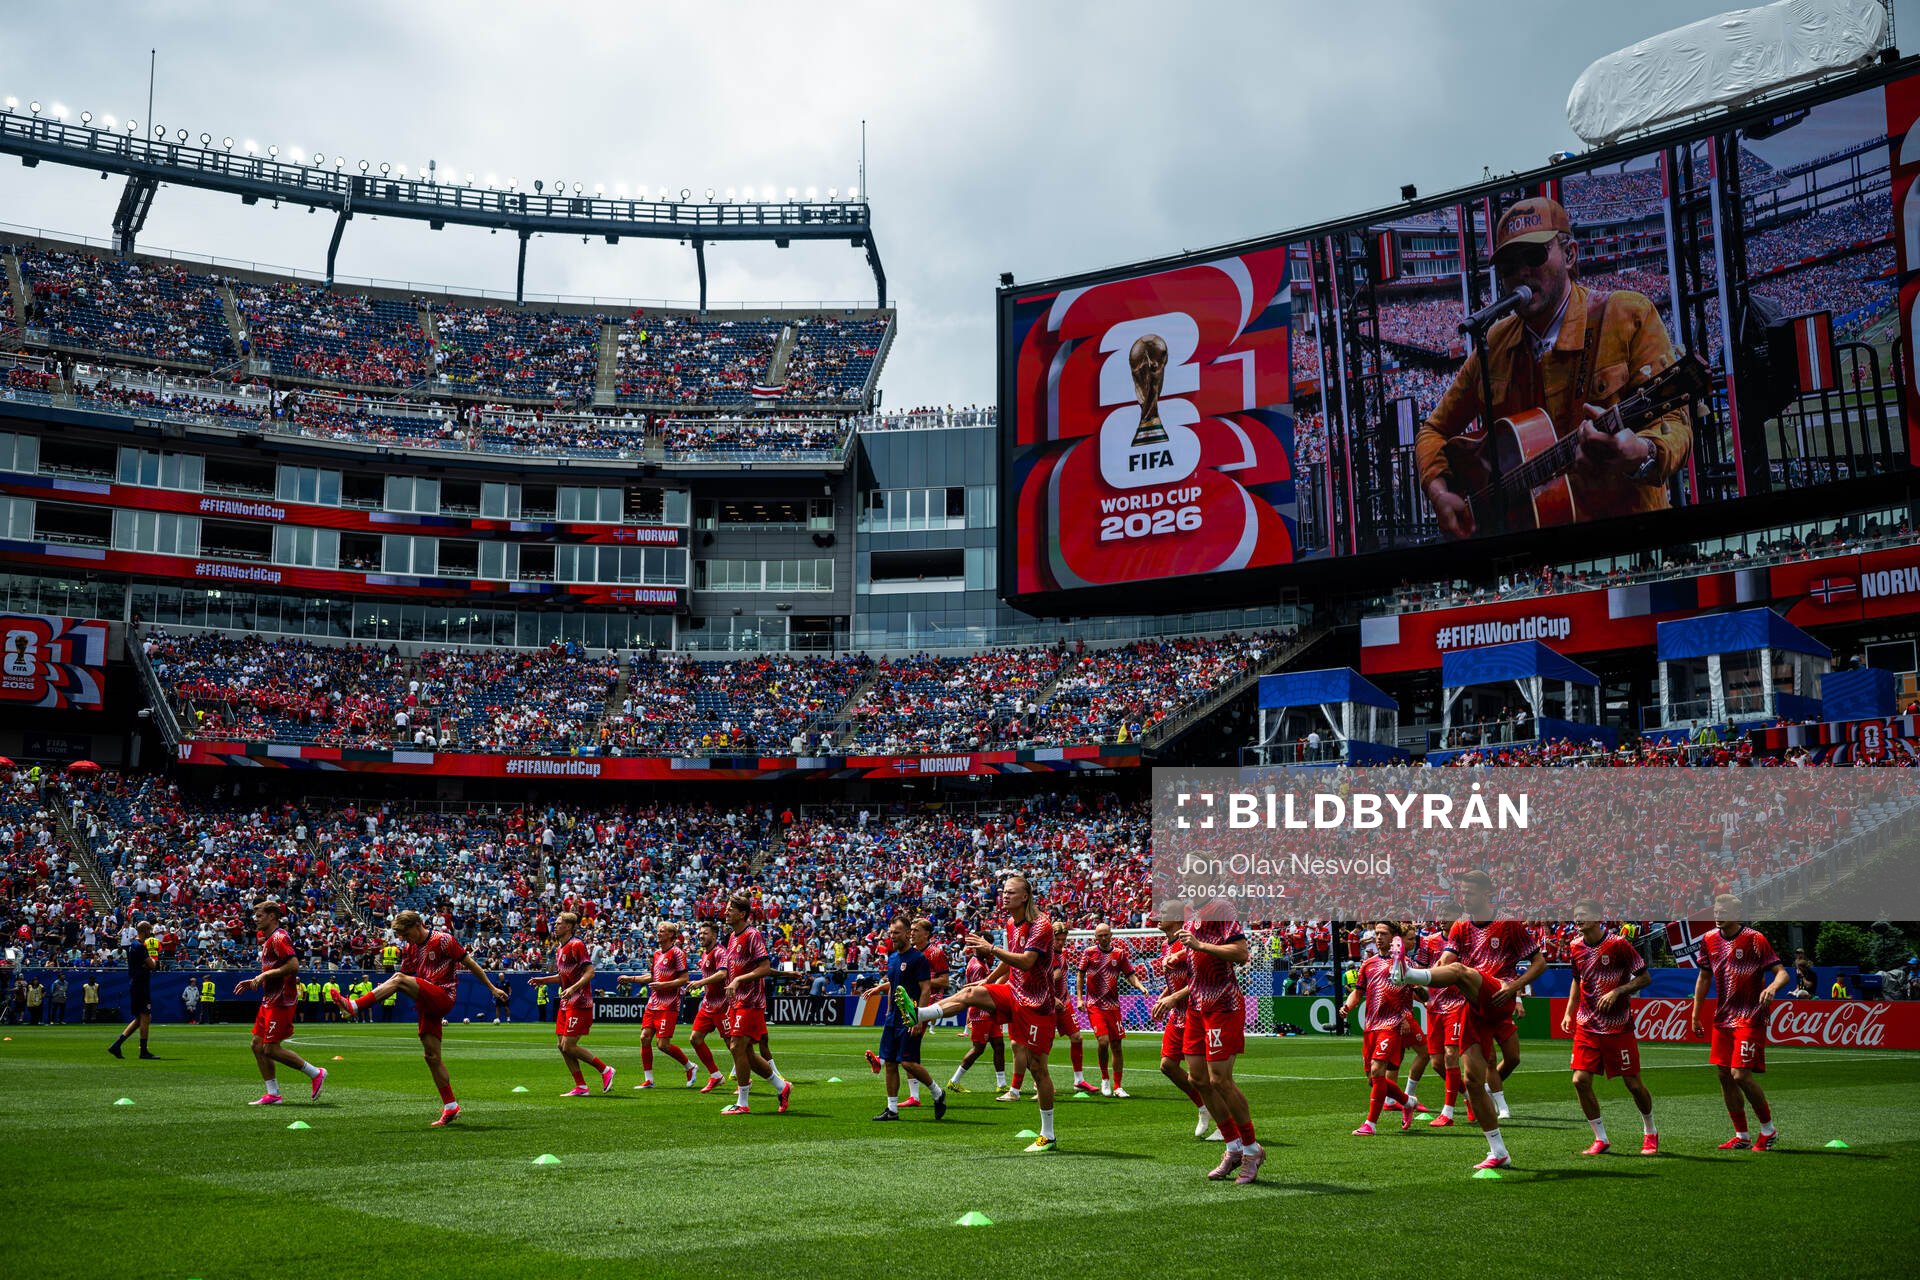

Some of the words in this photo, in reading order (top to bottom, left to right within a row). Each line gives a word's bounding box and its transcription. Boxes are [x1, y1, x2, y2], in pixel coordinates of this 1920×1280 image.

[1128, 449, 1174, 472] FIFA
[200, 497, 285, 521] #FIFAWorldCup
[1101, 491, 1164, 514] WORLD
[1167, 486, 1202, 503] CUP
[1100, 506, 1203, 541] 2026
[195, 562, 282, 584] #FIFAWorldCup
[1435, 614, 1571, 650] #FIFAWorldCup
[1, 681, 35, 690] 2026
[505, 758, 601, 777] #FIFAWorldCup
[919, 755, 971, 773] NORWAY
[766, 998, 838, 1022] IRWAYS
[268, 1021, 277, 1033] 7
[567, 1016, 579, 1029] 17
[660, 1018, 667, 1030] 2
[734, 1014, 742, 1028] 8
[1452, 1022, 1462, 1036] 11
[1766, 1001, 1891, 1046] Coca-Cola
[1029, 1024, 1039, 1042] 9
[1208, 1028, 1223, 1048] 18
[1379, 1038, 1390, 1051] 6
[1740, 1040, 1756, 1058] 24
[1620, 1049, 1631, 1065] 5
